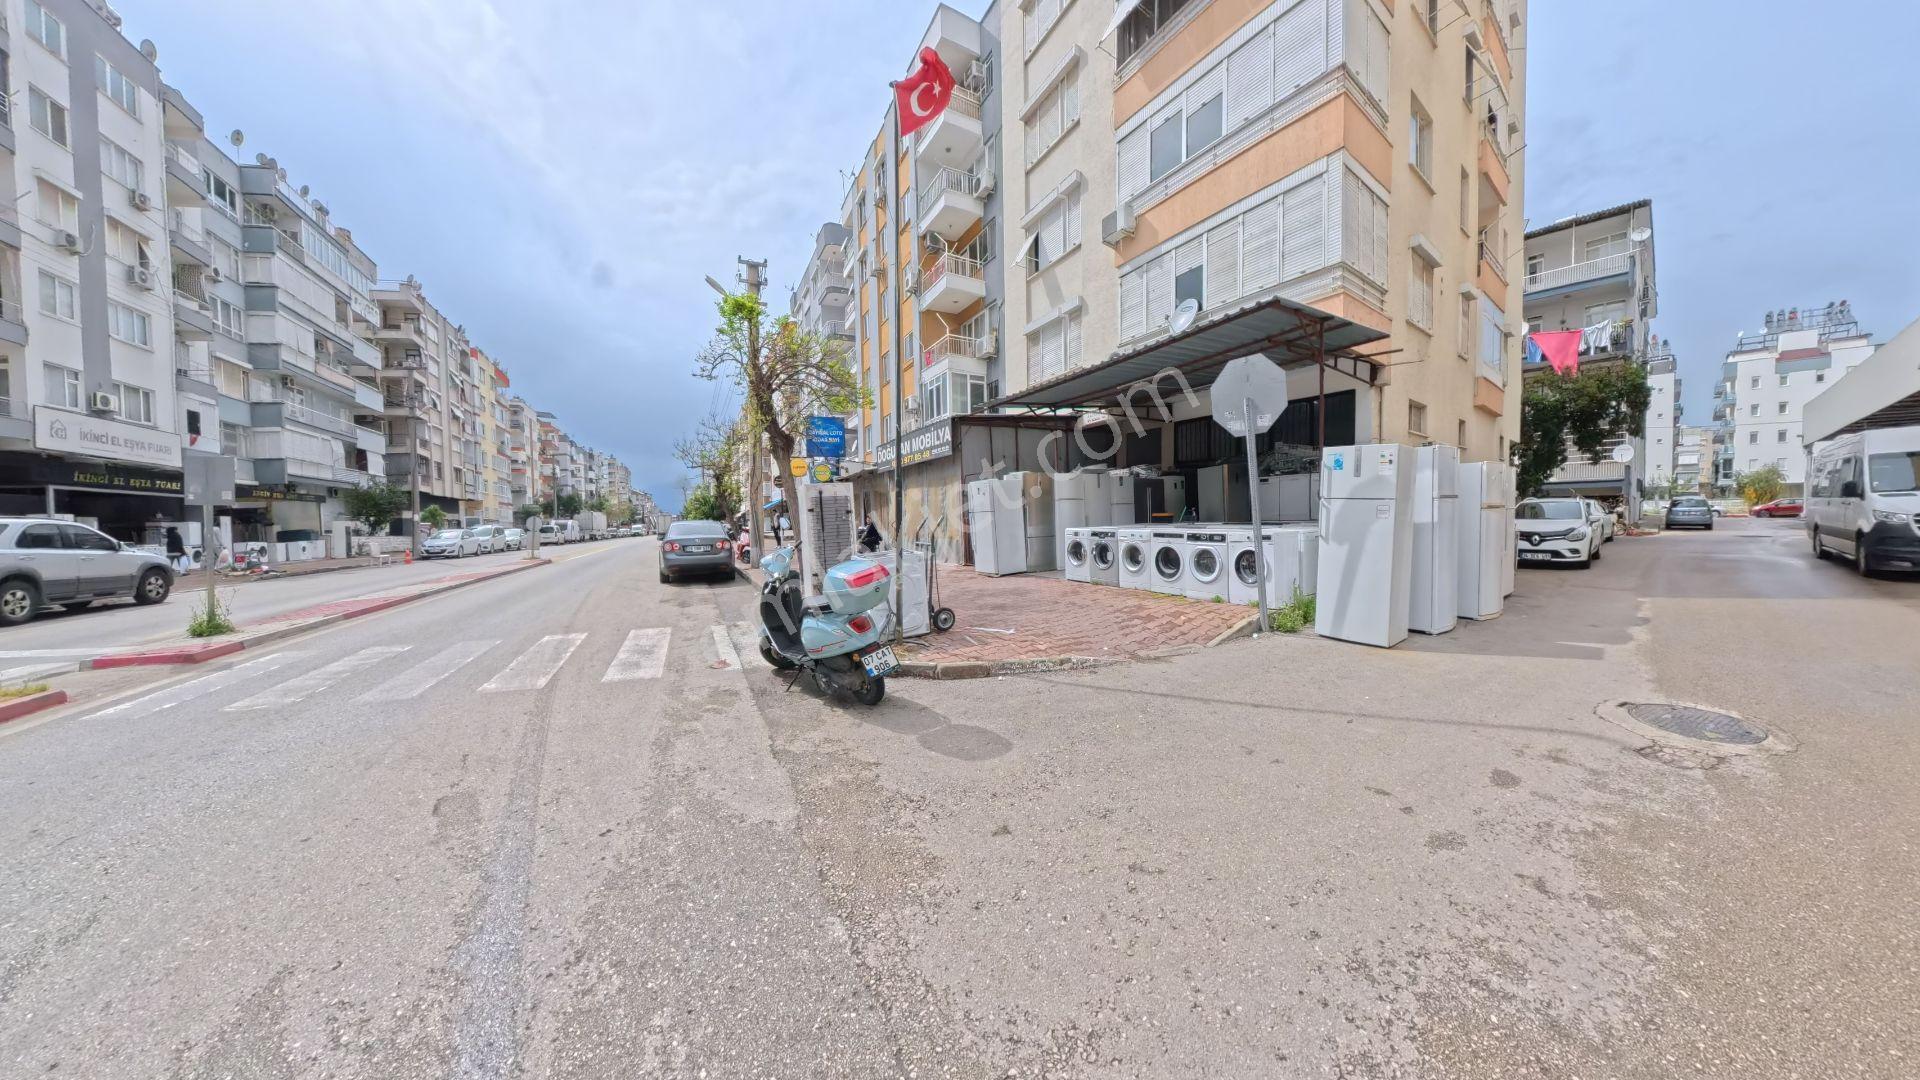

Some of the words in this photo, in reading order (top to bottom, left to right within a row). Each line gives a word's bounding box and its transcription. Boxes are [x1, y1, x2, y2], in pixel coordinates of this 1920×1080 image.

[110, 435, 122, 447] EL
[877, 441, 910, 463] DOĞUAN
[912, 426, 951, 452] MOBİLYA
[863, 655, 874, 666] 07
[875, 647, 891, 660] CAT
[874, 659, 890, 673] 906
